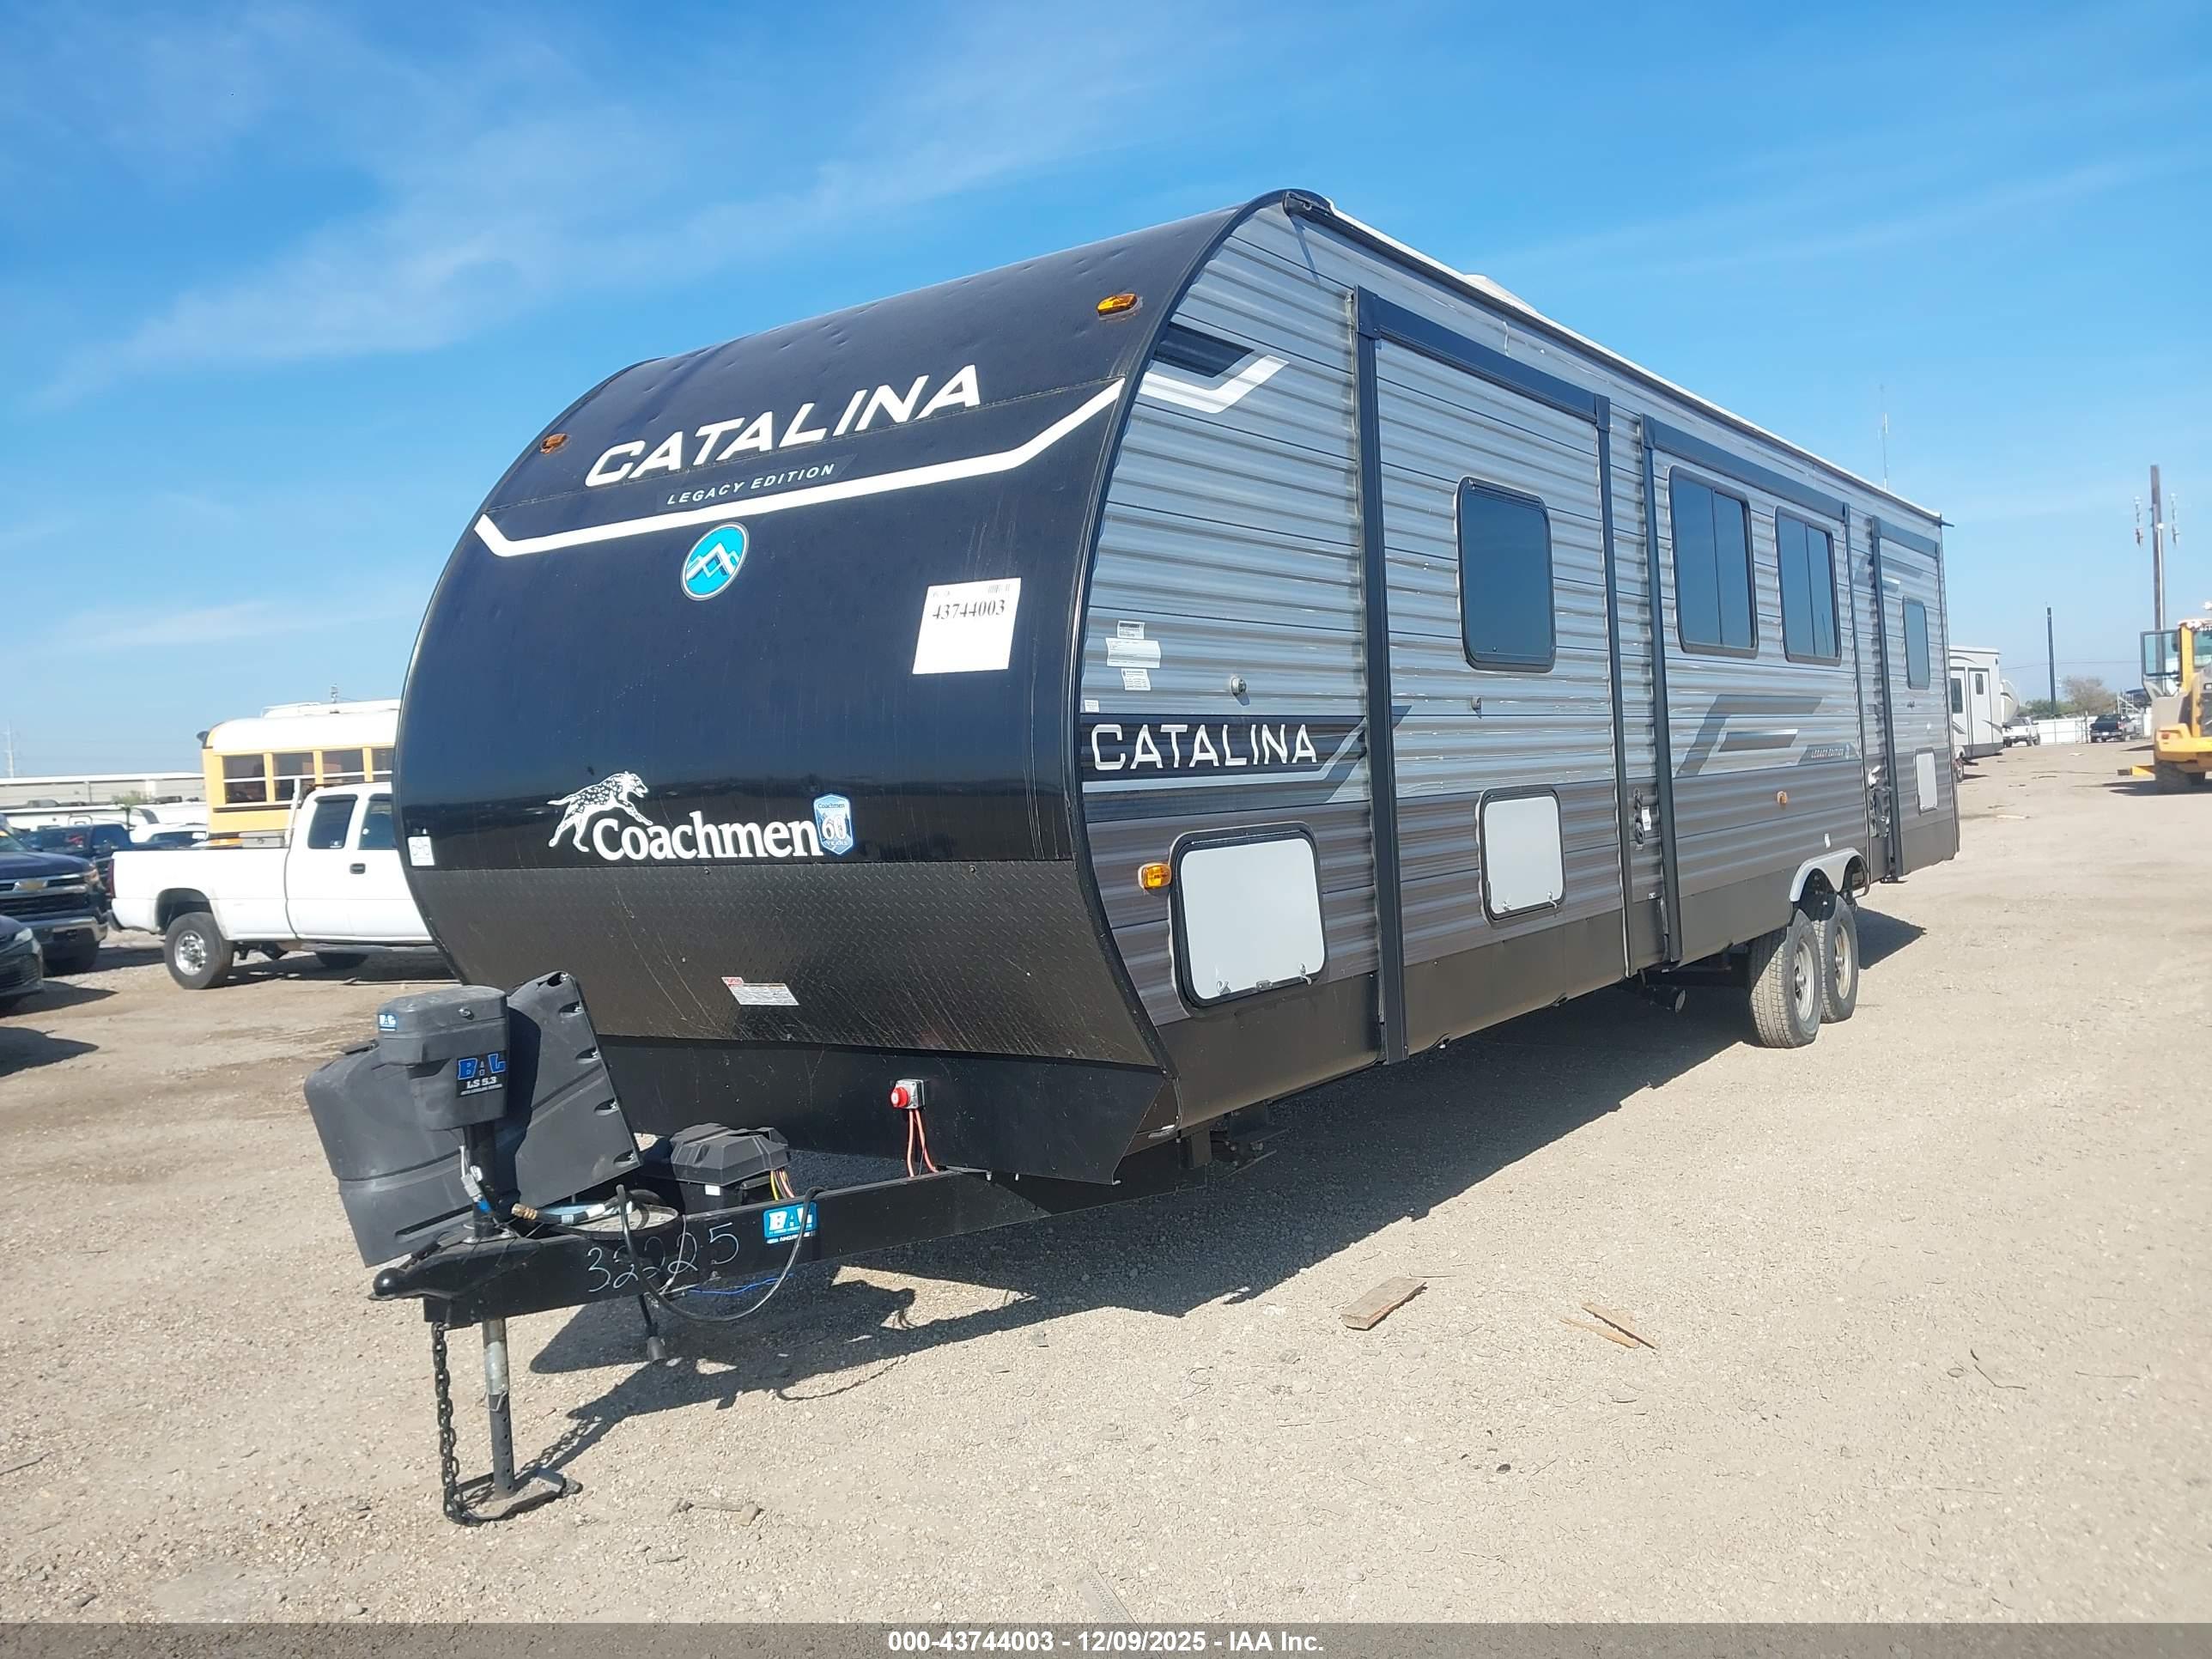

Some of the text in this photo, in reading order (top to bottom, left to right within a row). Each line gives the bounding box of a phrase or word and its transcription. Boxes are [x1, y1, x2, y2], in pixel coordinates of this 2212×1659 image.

[585, 364, 981, 488] CATALINA
[666, 463, 836, 506] LEGACY EDITION
[932, 599, 1006, 620] 43744003
[1090, 723, 1318, 771] CATALINA
[592, 810, 824, 860] Coachmen
